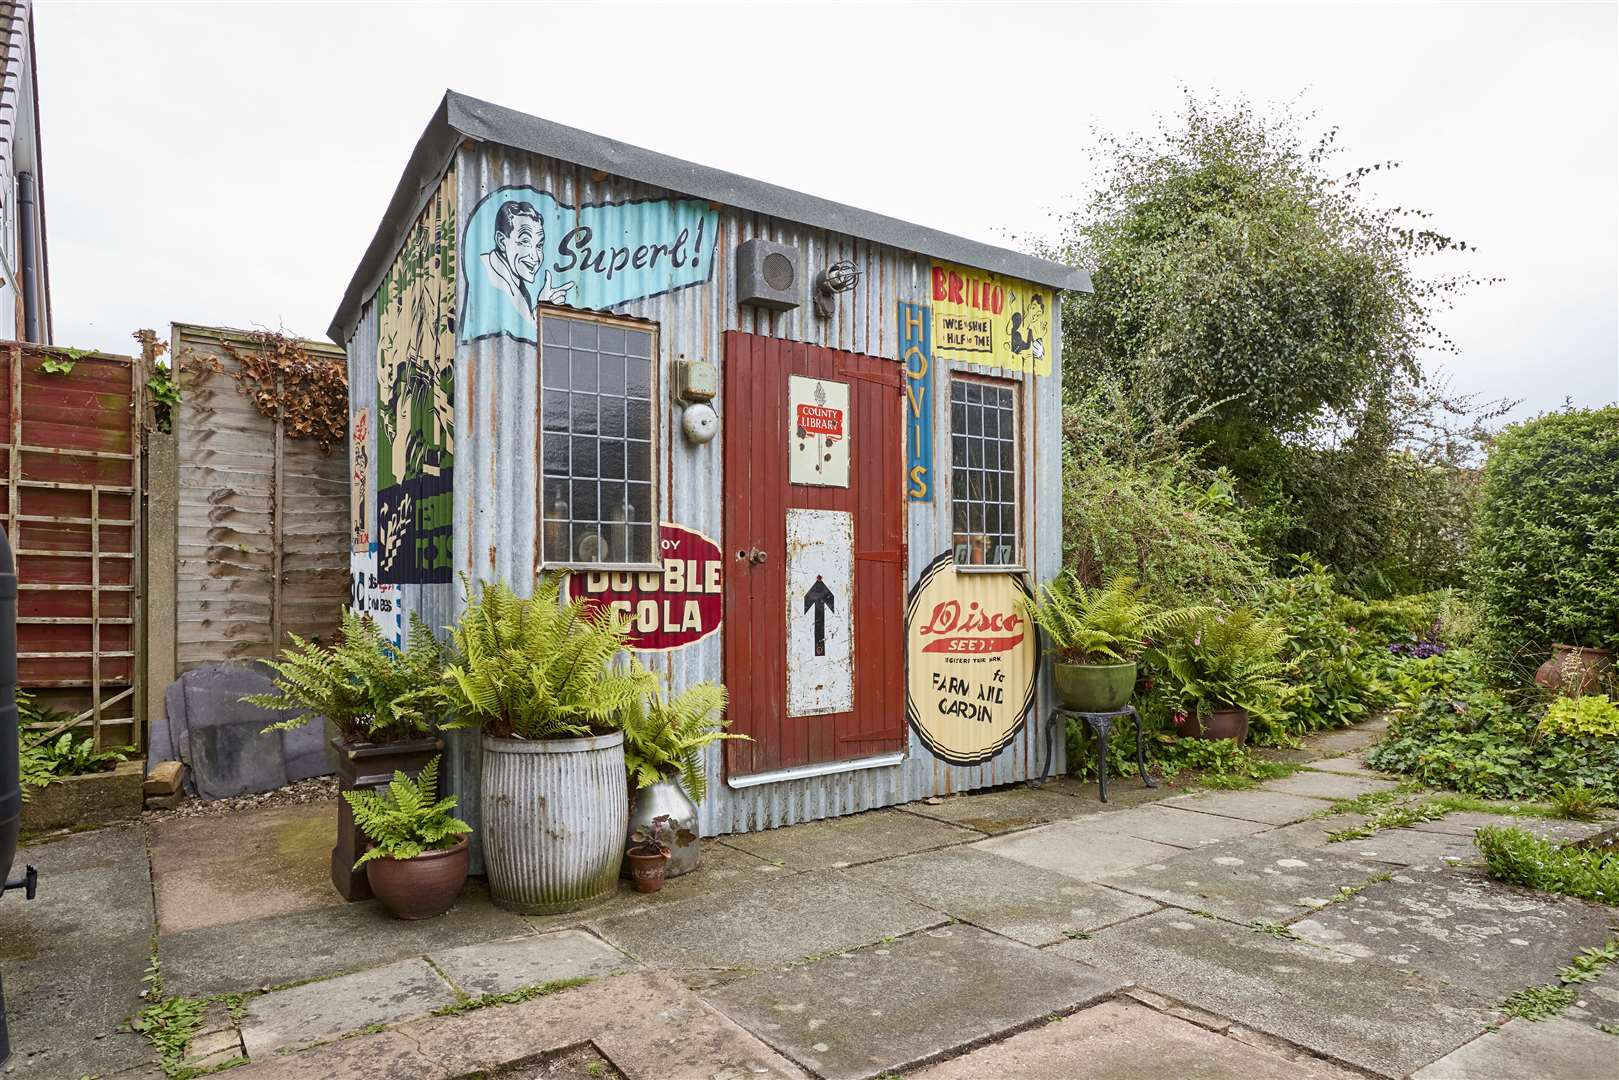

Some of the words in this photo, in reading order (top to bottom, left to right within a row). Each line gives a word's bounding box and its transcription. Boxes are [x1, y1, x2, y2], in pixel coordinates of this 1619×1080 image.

[553, 215, 705, 280] Superb!
[932, 266, 1004, 314] BRILLO
[802, 406, 837, 419] COUNTY
[905, 307, 928, 498] HOVIS
[801, 417, 838, 430] LIBRARY
[661, 539, 681, 550] OY
[587, 558, 722, 593] DOUBLE
[610, 600, 702, 633] COLA
[920, 599, 1024, 636] Disco
